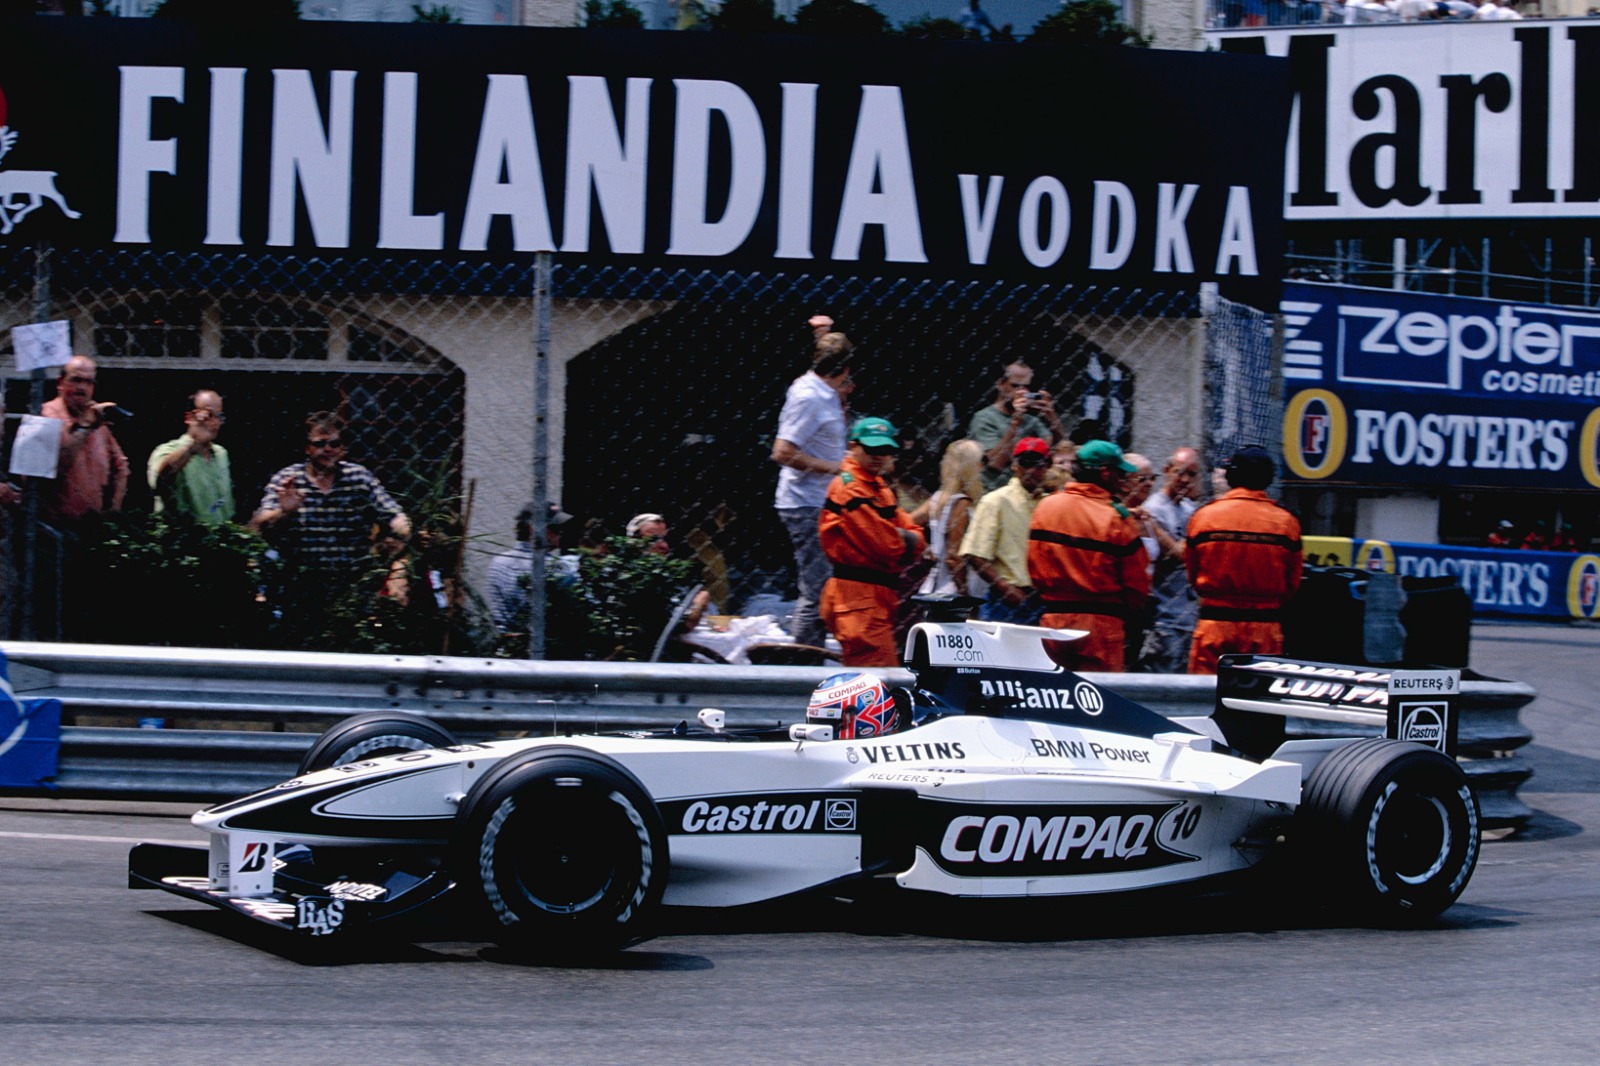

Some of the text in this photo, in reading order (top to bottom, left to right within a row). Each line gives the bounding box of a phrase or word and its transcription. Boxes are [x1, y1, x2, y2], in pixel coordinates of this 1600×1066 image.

[113, 65, 1258, 276] FINLANDIA VODKA
[1351, 409, 1575, 471] FOSTER'S
[935, 634, 973, 649] 11880
[953, 650, 984, 662] .com
[828, 681, 867, 700] COMPAQ
[980, 680, 1074, 710] Allianz
[1393, 679, 1444, 691] REUTERS
[1409, 726, 1441, 741] Castrol
[861, 742, 966, 764] VELTINS
[1030, 738, 1151, 764] BMW Power
[868, 772, 929, 783] REUTERS
[682, 800, 821, 833] Castrol
[1169, 804, 1202, 841] 10
[940, 814, 1155, 863] COMPAQ
